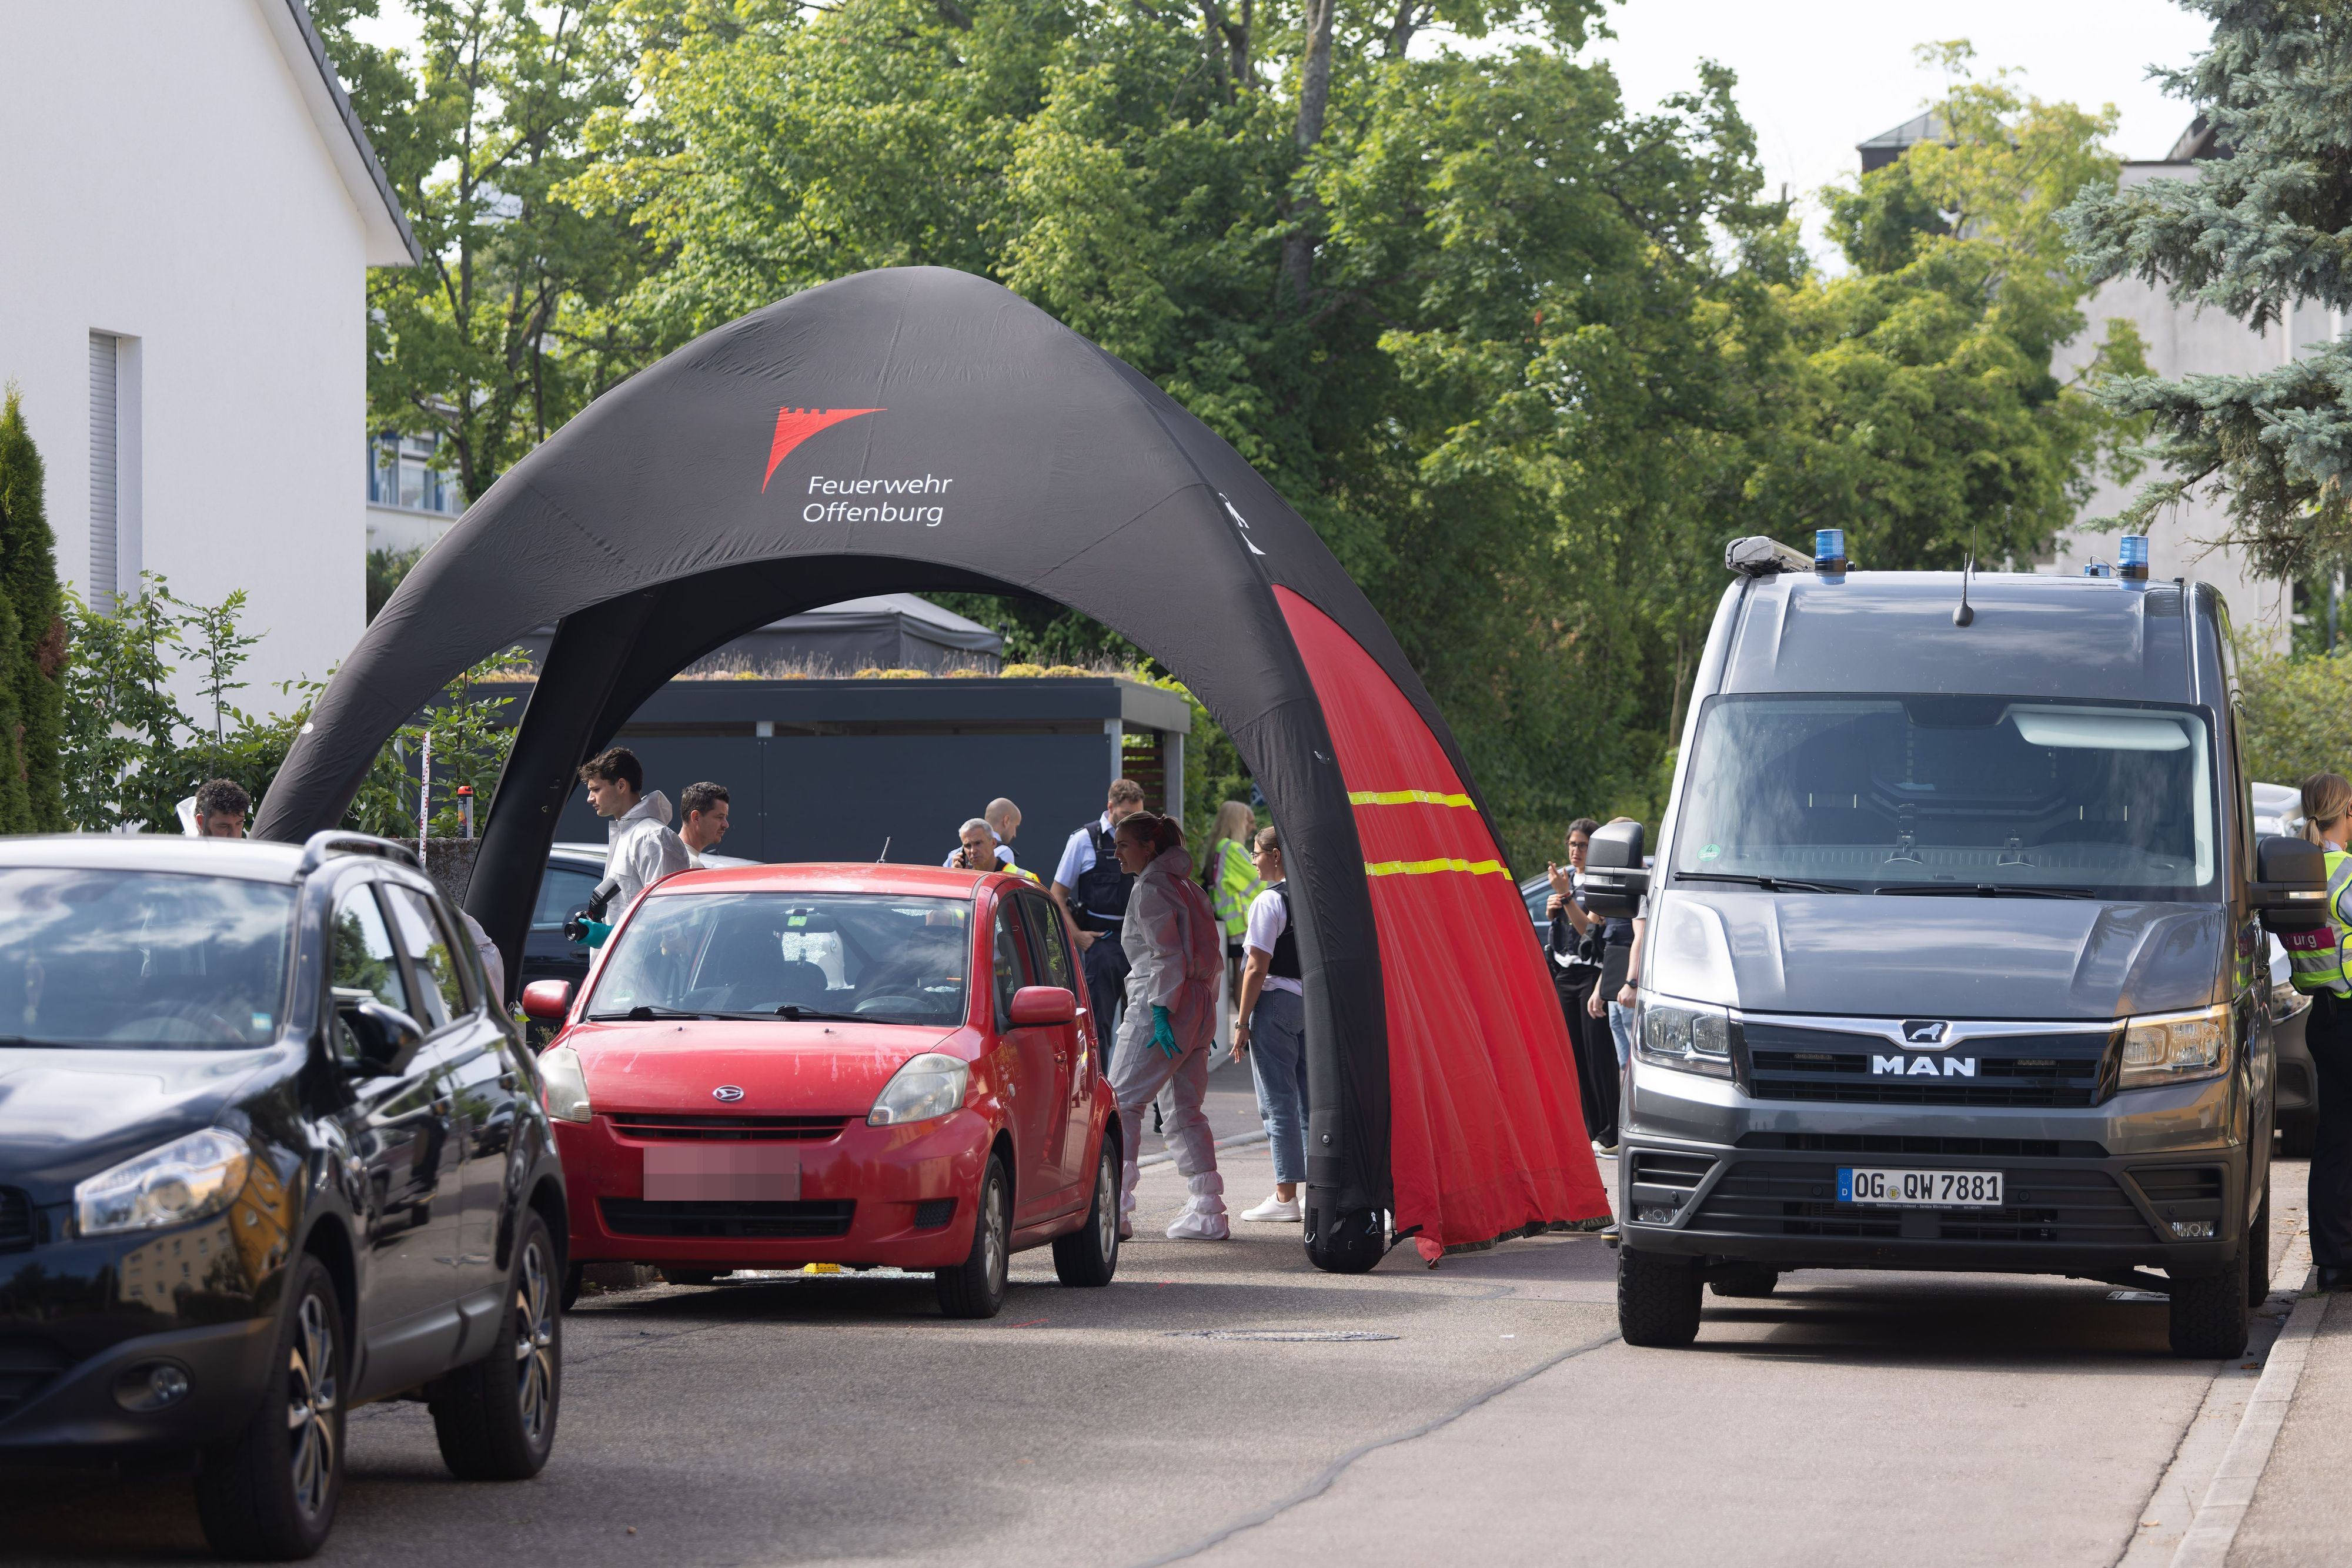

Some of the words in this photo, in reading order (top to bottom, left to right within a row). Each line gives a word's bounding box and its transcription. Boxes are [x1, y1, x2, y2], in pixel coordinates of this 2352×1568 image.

[808, 474, 953, 495] Feuerwehr
[803, 502, 943, 527] Offenburg
[1706, 844, 1713, 852] 4
[1873, 1055, 1975, 1076] MAN
[1855, 1172, 1885, 1198] OG
[1904, 1174, 1933, 1199] QW
[1941, 1175, 1999, 1201] 7881
